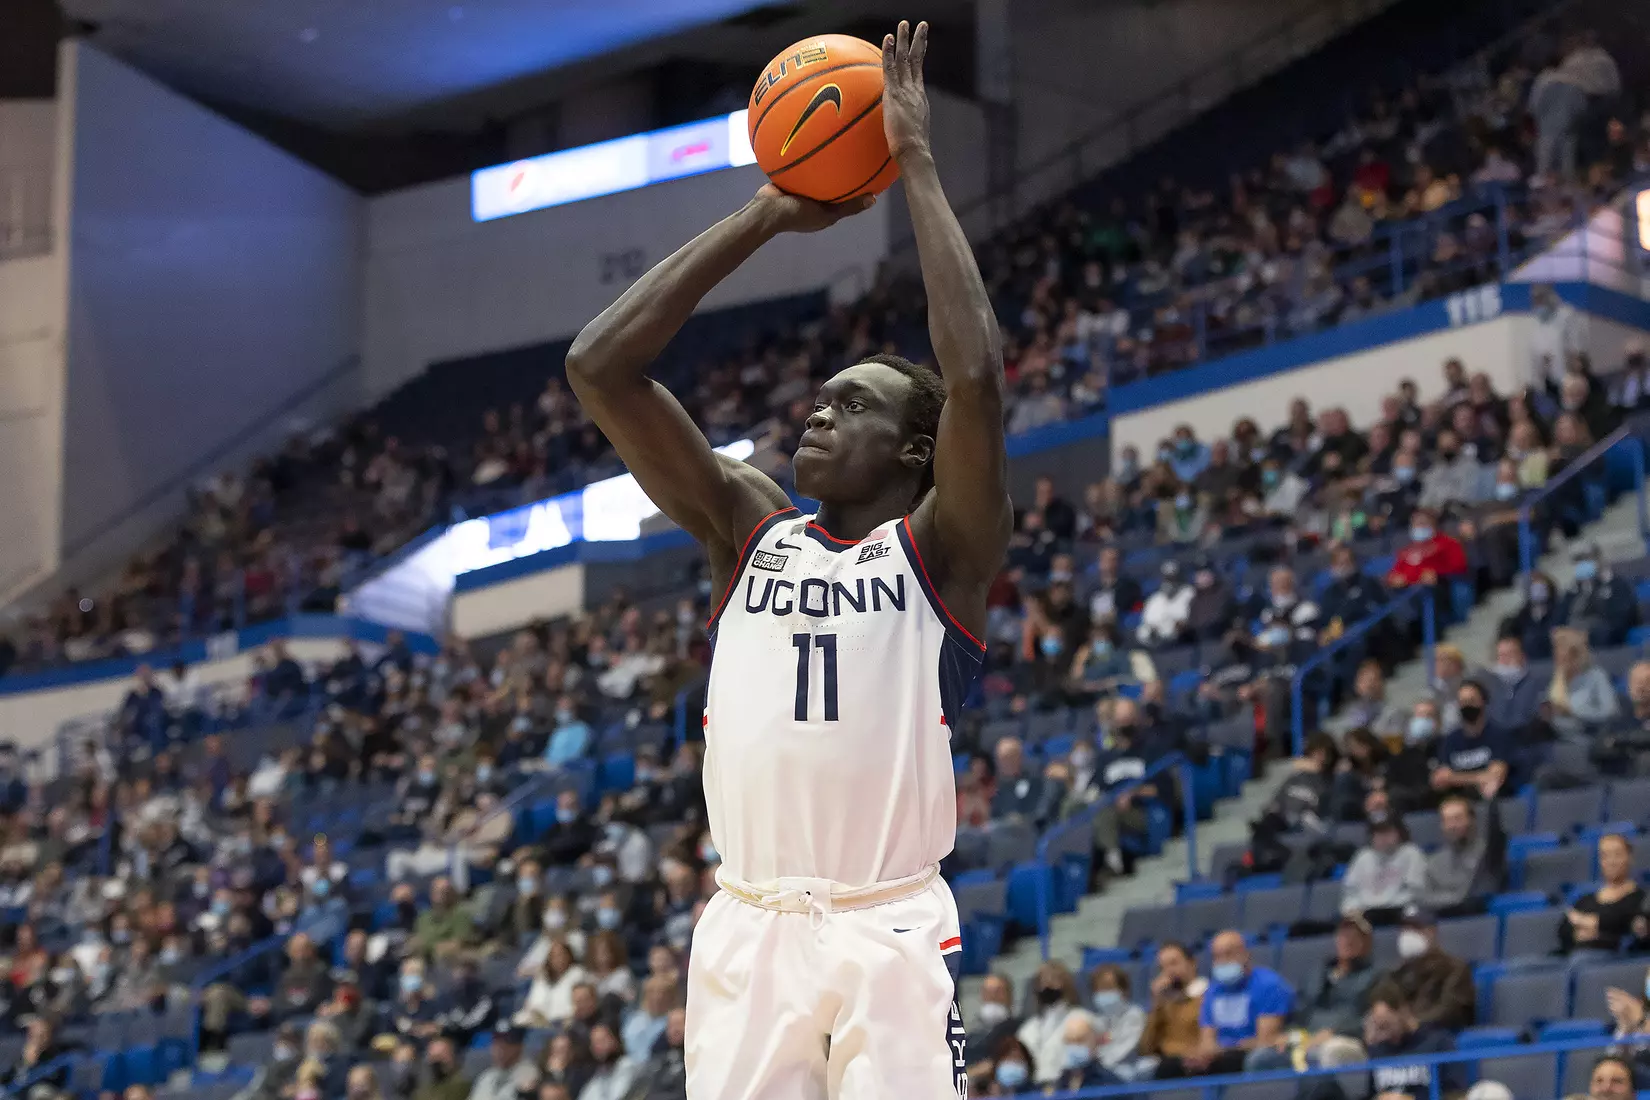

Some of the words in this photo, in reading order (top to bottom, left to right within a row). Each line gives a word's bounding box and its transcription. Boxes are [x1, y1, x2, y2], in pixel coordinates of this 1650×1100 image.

[754, 43, 829, 107] ELITE
[857, 547, 892, 561] EAST
[860, 541, 884, 554] BIG
[745, 573, 907, 618] UCONN
[792, 633, 839, 722] 11
